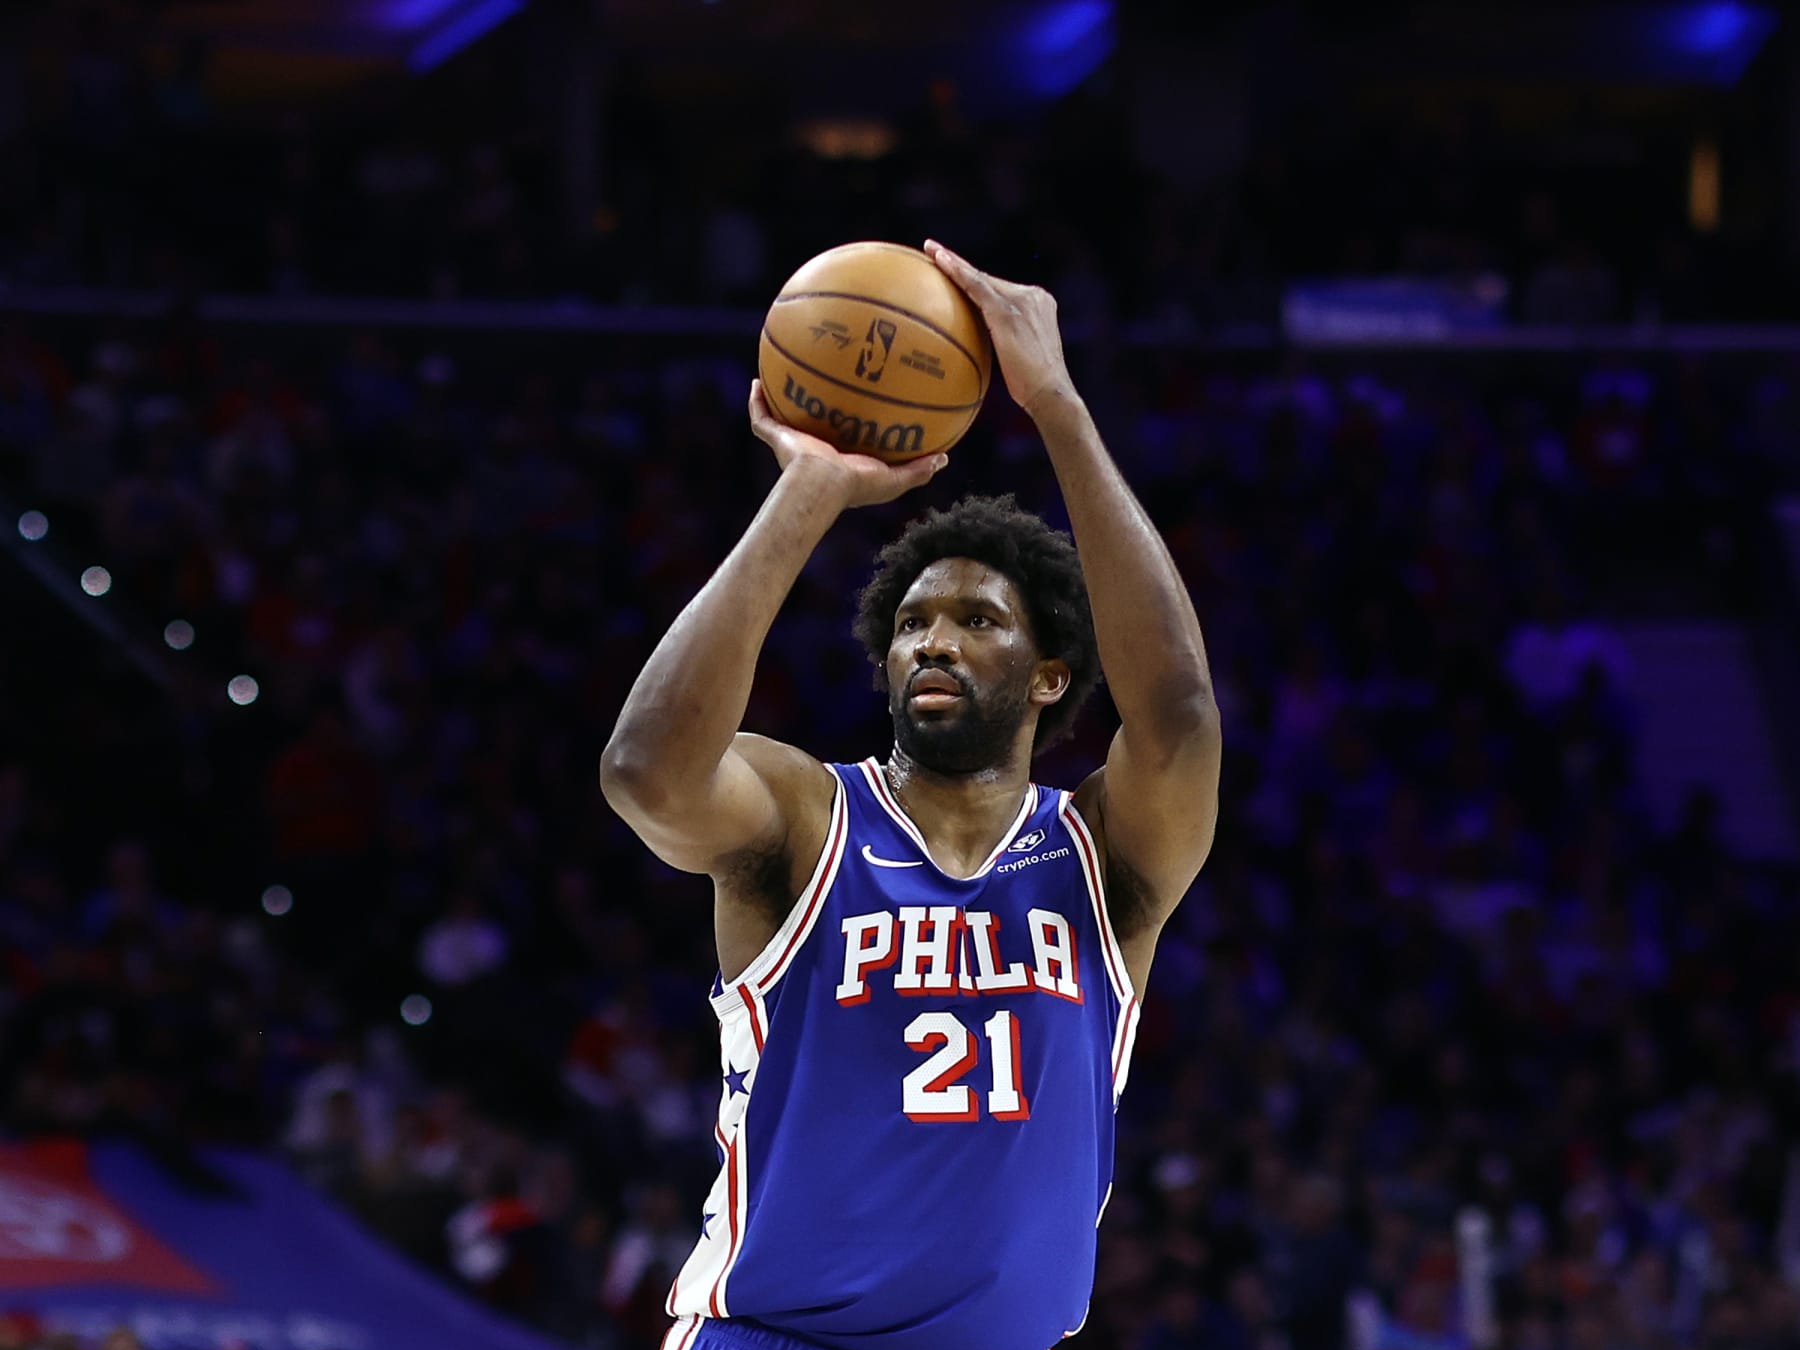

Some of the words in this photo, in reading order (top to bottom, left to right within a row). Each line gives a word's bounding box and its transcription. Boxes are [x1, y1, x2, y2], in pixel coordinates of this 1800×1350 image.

[783, 374, 925, 451] Wilson
[997, 847, 1070, 873] crypto.com
[903, 1010, 1029, 1122] 21
